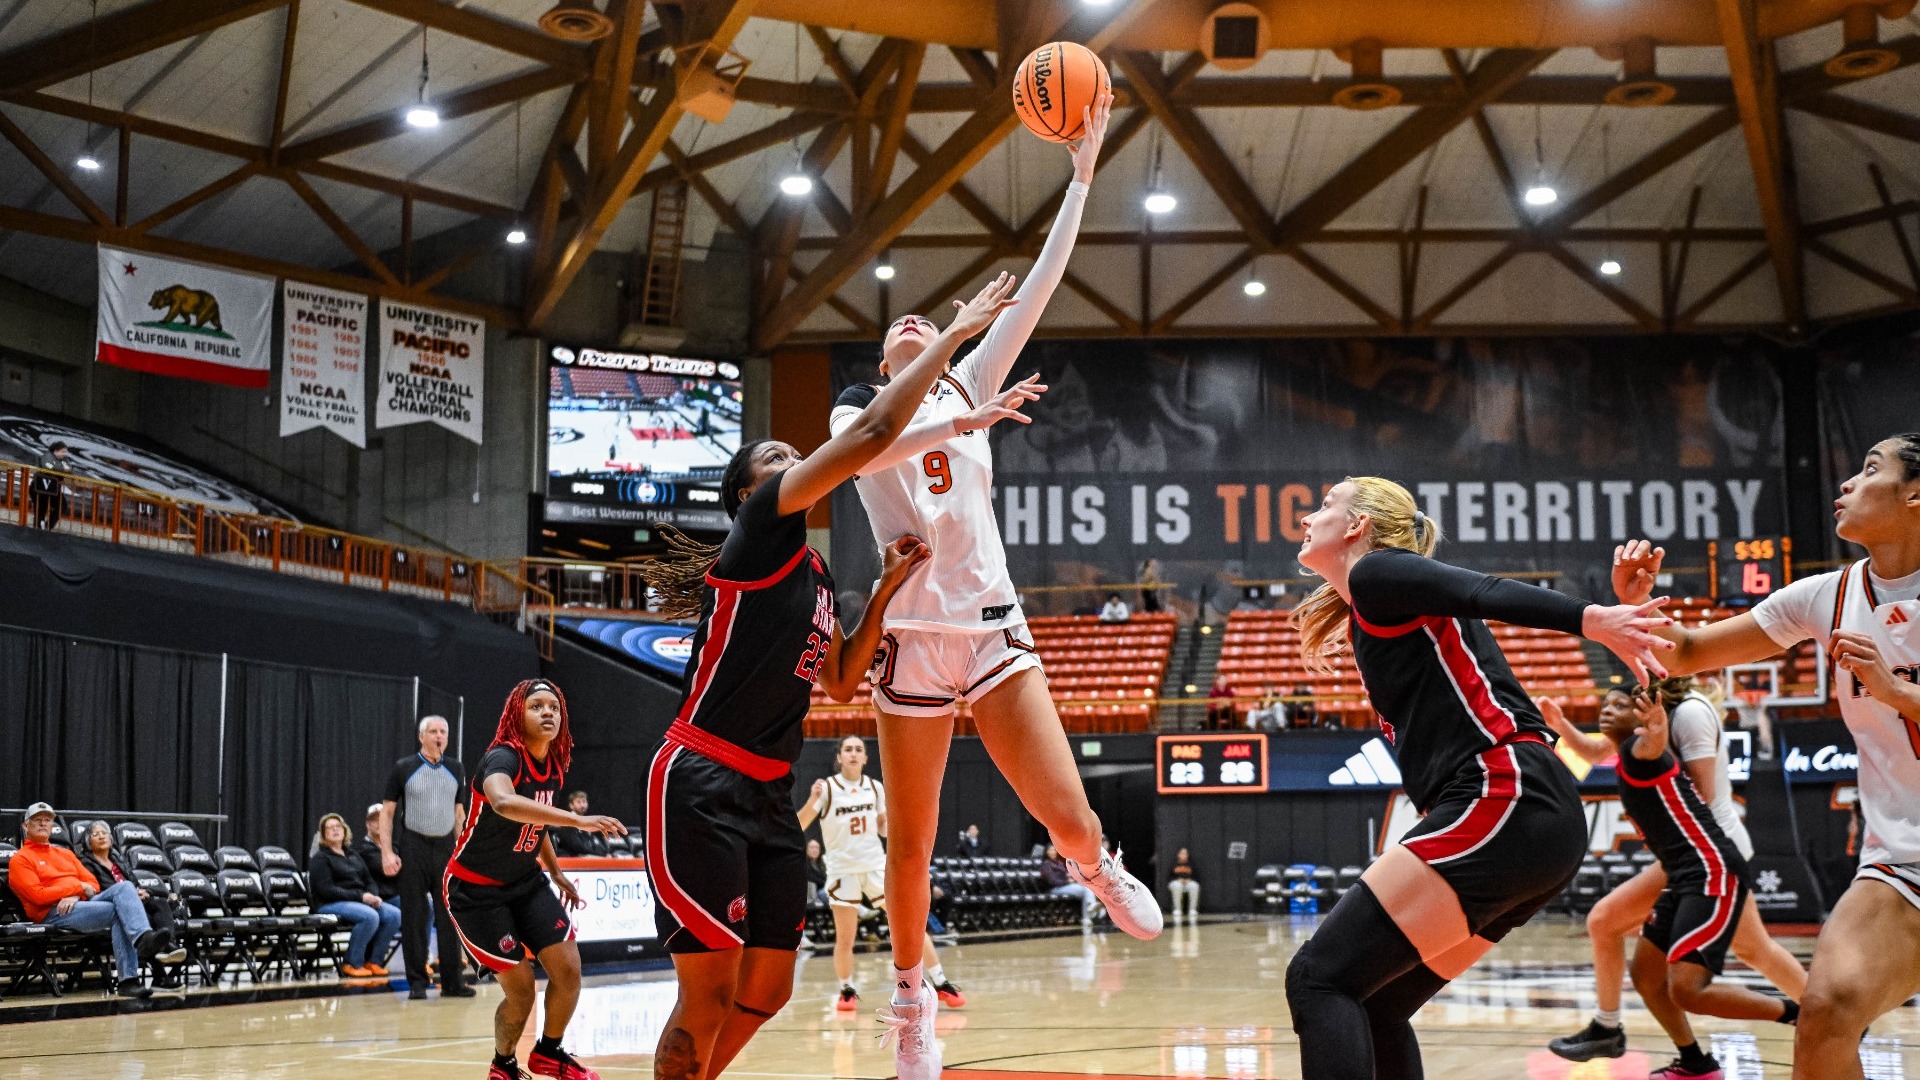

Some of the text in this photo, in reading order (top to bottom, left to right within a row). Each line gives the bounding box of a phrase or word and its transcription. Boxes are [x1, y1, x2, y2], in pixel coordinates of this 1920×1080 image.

[1035, 47, 1053, 112] Wilson
[287, 288, 364, 311] UNIVERSITY
[297, 309, 358, 332] PACIFIC
[386, 305, 479, 337] UNIVERSITY
[414, 323, 449, 337] OF THE
[126, 329, 242, 359] CALIFORNIA REPUBLIC
[393, 329, 470, 359] PACIFIC
[409, 362, 452, 380] NCAA
[300, 382, 346, 401] NCAA
[386, 371, 474, 399] VOLLEYBALL
[286, 396, 359, 415] VOLLEYBALL
[395, 386, 465, 410] NATIONAL
[288, 406, 356, 424] FINAL FOUR
[388, 397, 471, 423] CHAMPIONS
[923, 451, 952, 494] 9
[572, 505, 596, 517] Best
[600, 507, 644, 521] Western
[646, 510, 674, 522] PLUS
[992, 479, 1762, 545] HIS IS TIG TERRITORY
[1171, 744, 1252, 759] PAC JAX
[1170, 762, 1204, 784] 23
[850, 815, 867, 836] 21
[513, 823, 545, 852] 15
[596, 877, 649, 909] Dignity
